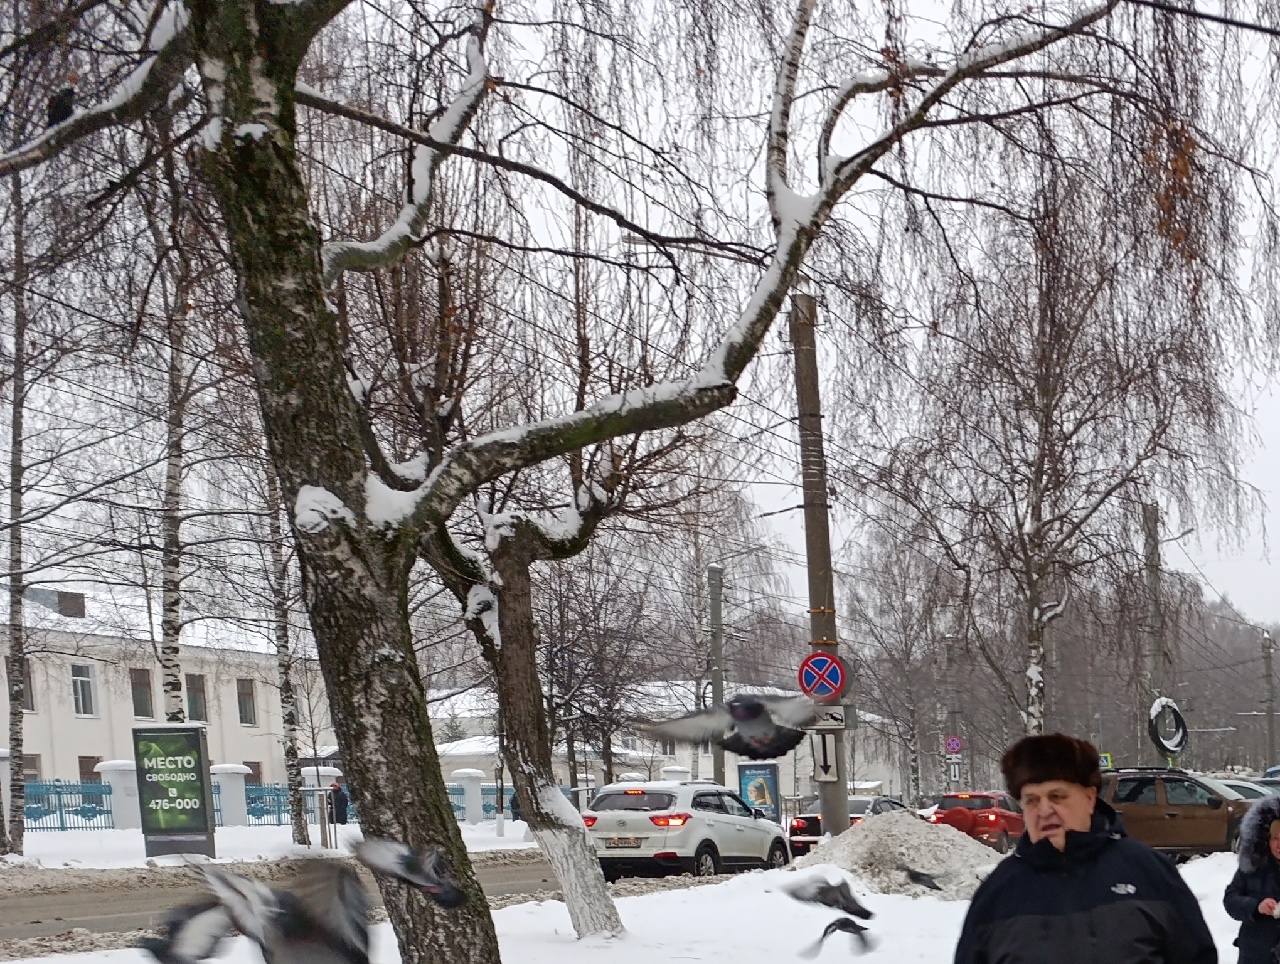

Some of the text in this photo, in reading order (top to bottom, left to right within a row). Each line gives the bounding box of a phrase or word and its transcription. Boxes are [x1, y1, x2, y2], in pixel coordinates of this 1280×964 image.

[144, 756, 195, 769] МЕСТО
[145, 773, 197, 782] СВОБОДНО
[149, 799, 200, 809] 476-000
